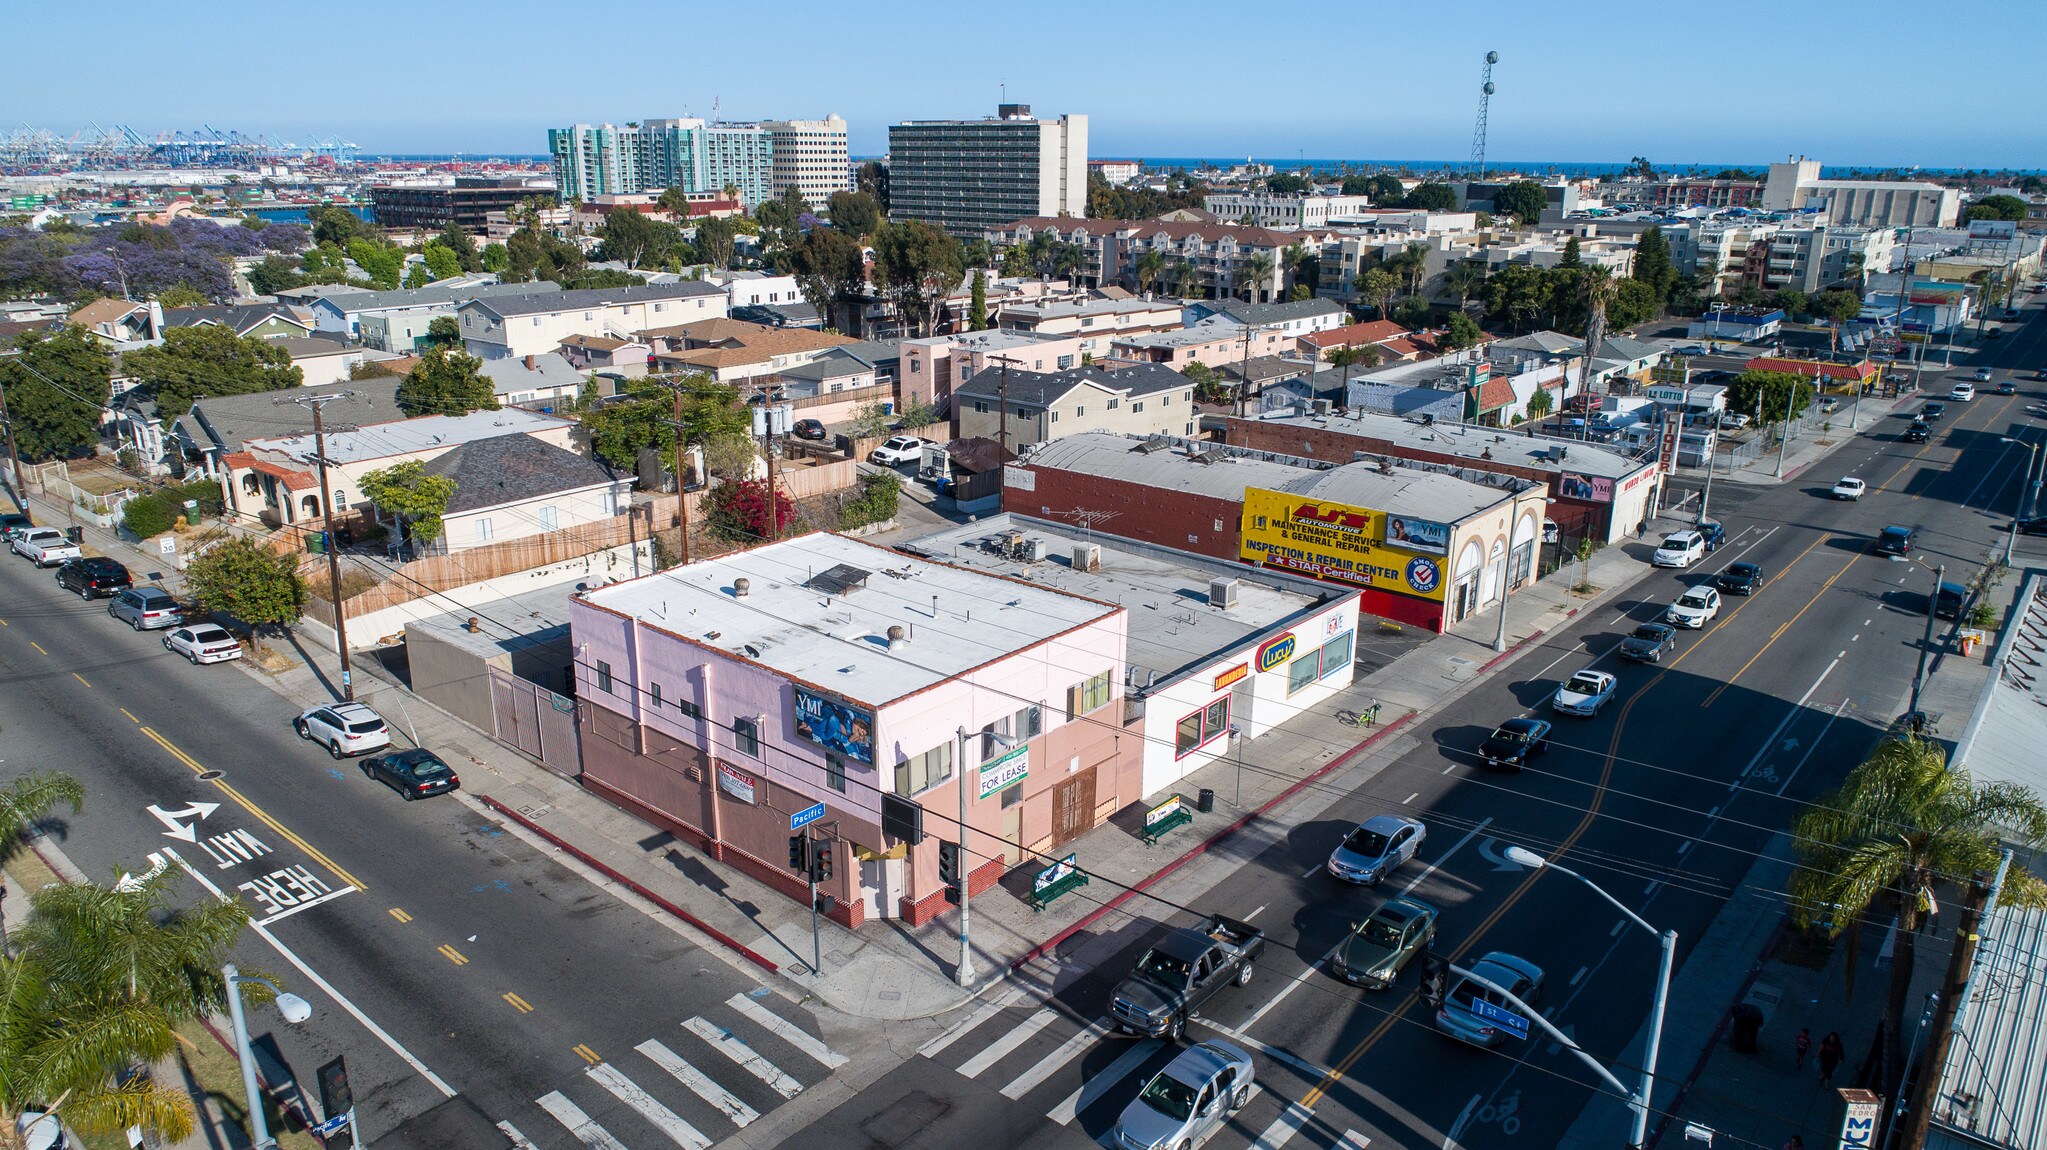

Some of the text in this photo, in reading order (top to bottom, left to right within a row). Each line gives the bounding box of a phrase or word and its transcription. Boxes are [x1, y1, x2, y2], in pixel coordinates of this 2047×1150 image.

[1659, 390, 1682, 401] LOTTO
[1660, 414, 1675, 471] LIQUOR
[1594, 483, 1610, 493] YMI
[1292, 505, 1371, 529] AJ'S
[1298, 518, 1361, 535] AUTOMOTIVE
[1271, 519, 1382, 549] MAINTENANCE SERVICE
[1281, 530, 1371, 555] & GENERAL REPAIR
[1421, 524, 1442, 538] YMI
[1246, 539, 1399, 580] INSPECTION & REPAIR CENTER
[1413, 558, 1435, 569] SMOG
[1288, 559, 1372, 584] STAR Certified.
[1409, 578, 1434, 591] CHECK
[1266, 638, 1293, 666] Lucy's
[797, 694, 822, 716] YMI
[734, 774, 753, 786] SALE
[982, 776, 999, 792] FOR
[1002, 763, 1026, 782] LEASE
[793, 808, 822, 826] Pacific
[197, 828, 274, 870] WAIT
[237, 864, 333, 915] HERE
[1478, 1003, 1498, 1017] 1st
